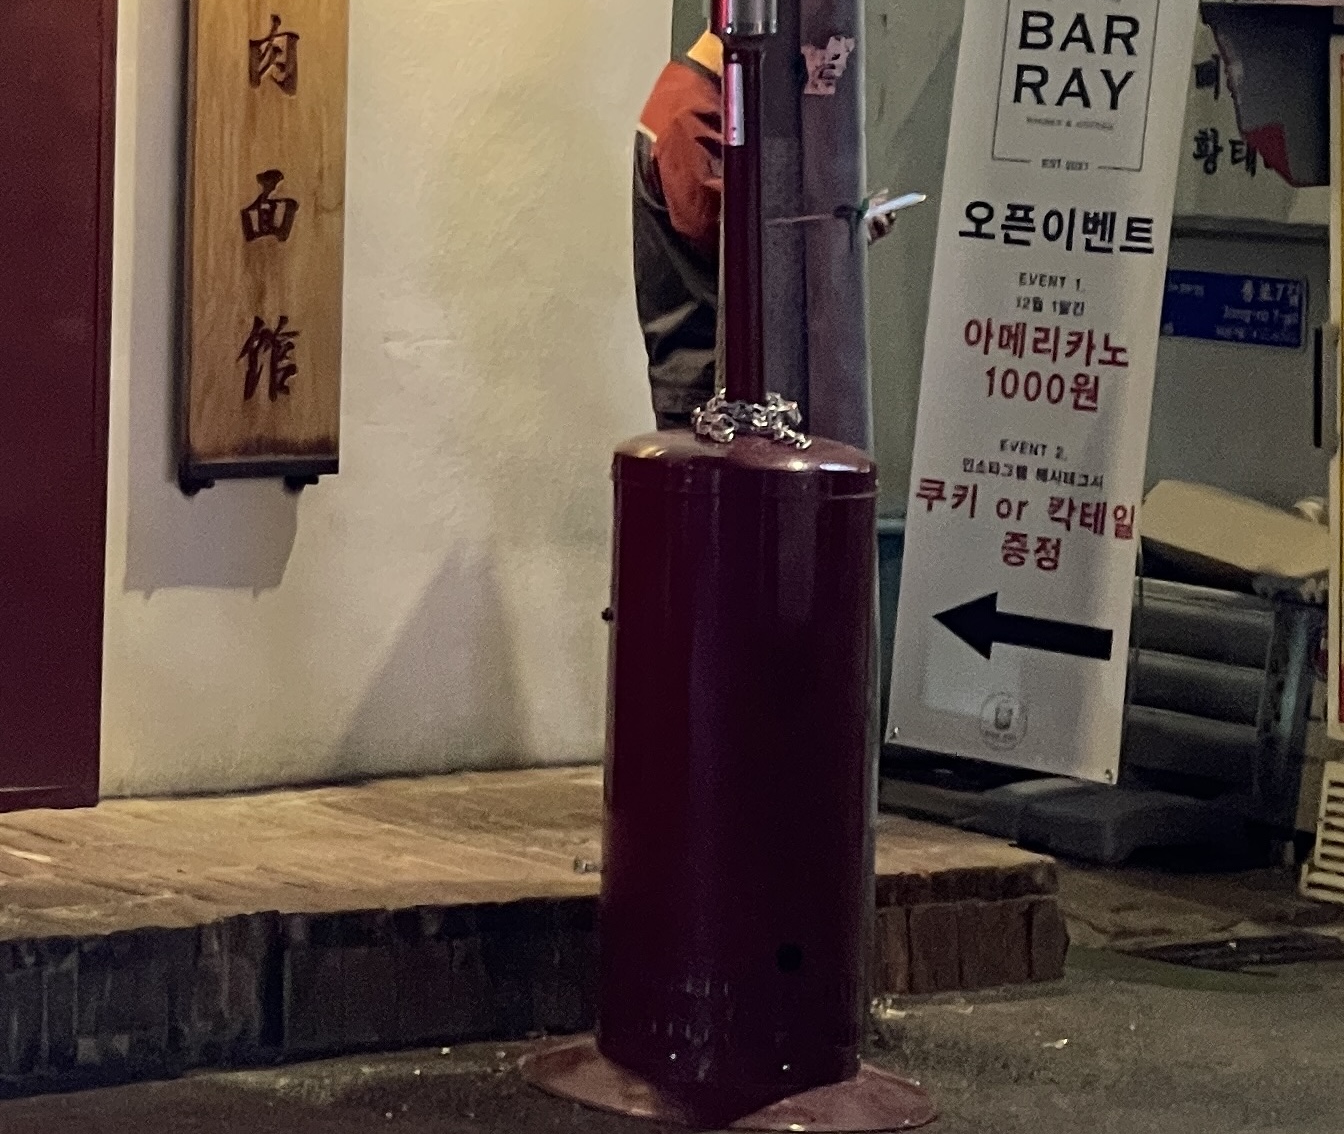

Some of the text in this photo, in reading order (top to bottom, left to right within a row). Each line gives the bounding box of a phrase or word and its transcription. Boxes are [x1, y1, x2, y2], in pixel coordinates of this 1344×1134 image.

[1018, 9, 1141, 57] BAR
[1012, 63, 1135, 111] RAY
[958, 200, 1155, 254] 오픈이벤트
[1018, 271, 1067, 288] EVENT
[963, 318, 1130, 369] 아메리카노
[984, 366, 1101, 413] 1000원
[999, 438, 1048, 457] EVENT
[916, 476, 1137, 541] 쿠키 or 칵테일
[1000, 530, 1064, 572] 증정
